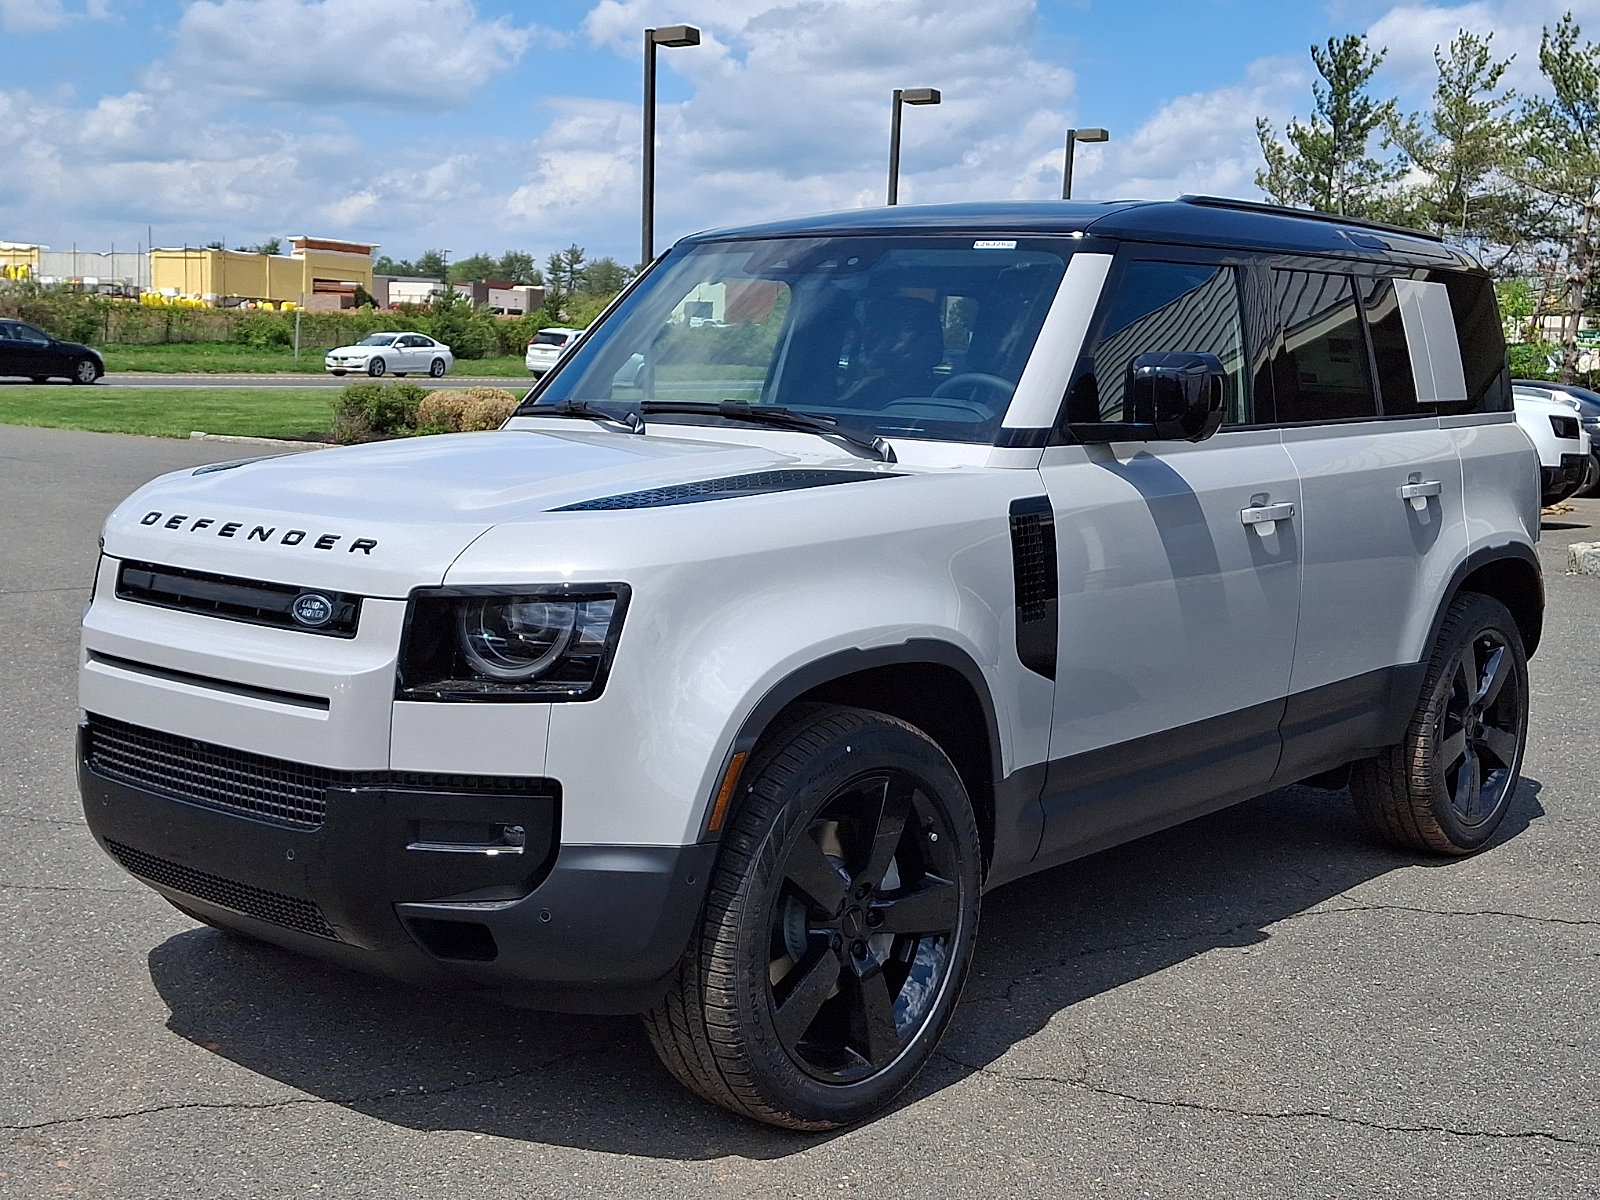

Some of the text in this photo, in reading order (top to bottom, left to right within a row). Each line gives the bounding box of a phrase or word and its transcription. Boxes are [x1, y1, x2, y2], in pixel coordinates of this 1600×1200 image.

[139, 511, 378, 555] DEFENDER
[301, 600, 320, 610] LAND
[301, 608, 324, 618] ROVER
